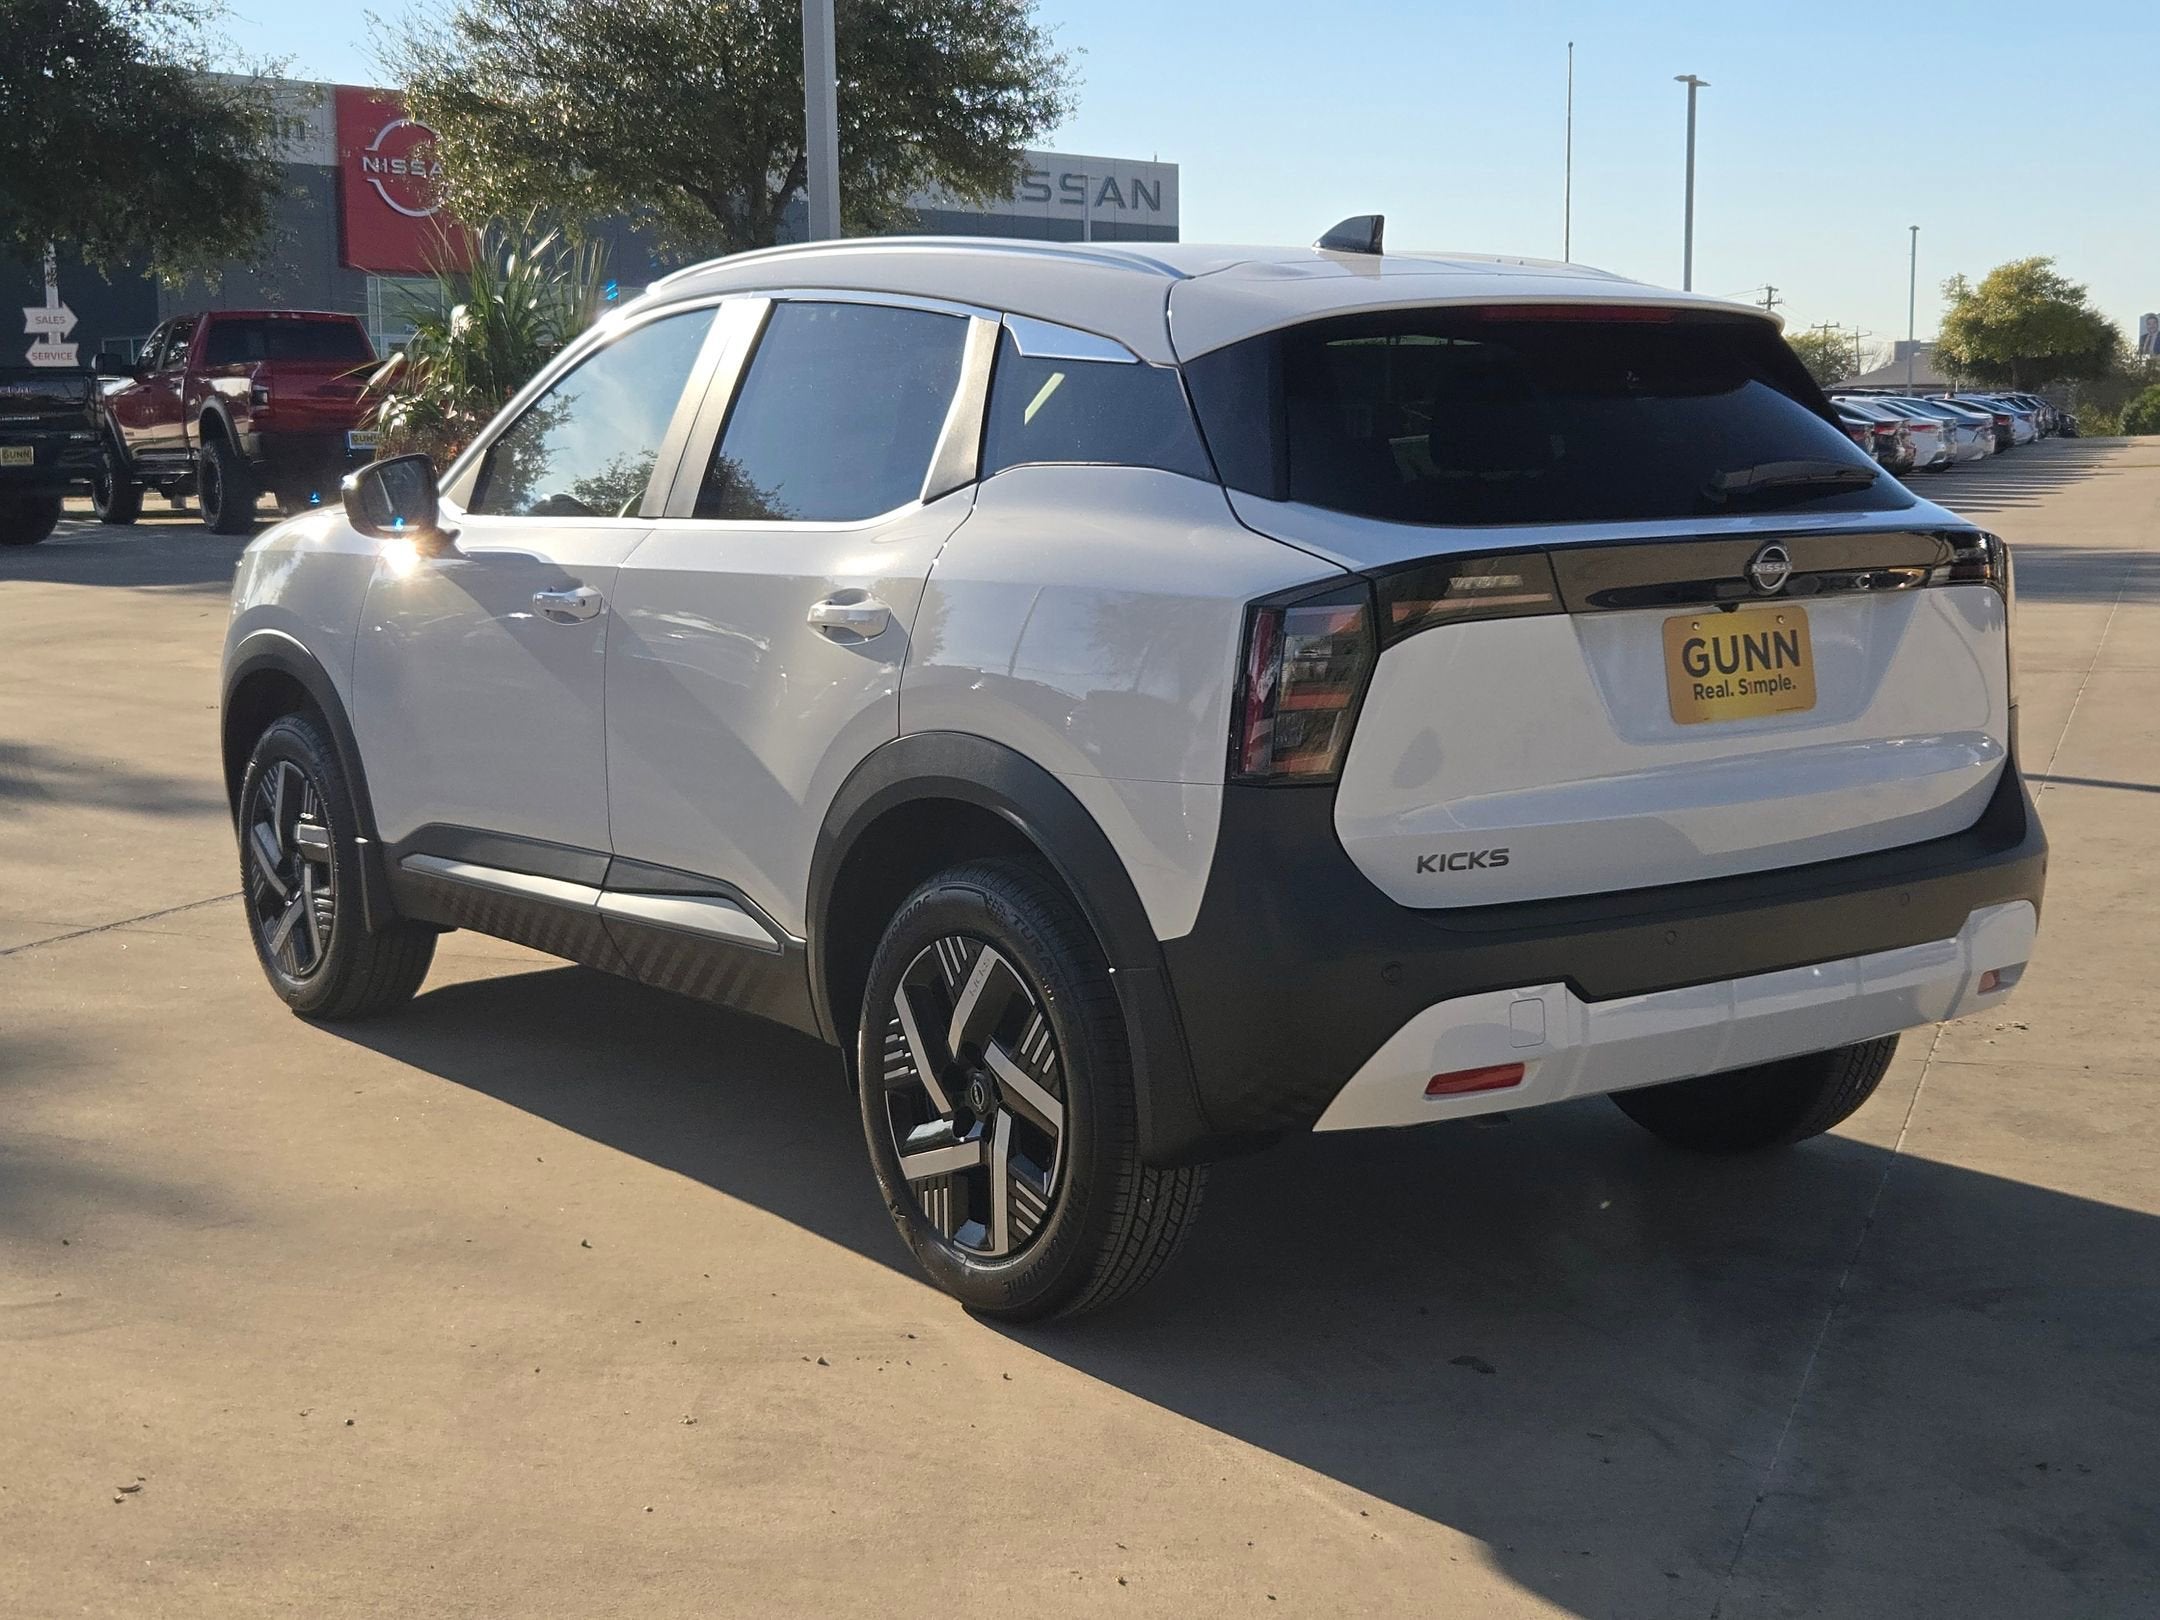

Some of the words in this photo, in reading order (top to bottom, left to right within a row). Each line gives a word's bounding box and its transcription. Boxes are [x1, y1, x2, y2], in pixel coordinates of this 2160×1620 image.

[362, 156, 445, 176] NISSA
[1019, 170, 1161, 212] SSAN
[35, 315, 66, 325] SALES
[31, 351, 73, 361] SERVICE
[1682, 629, 1801, 678] GUNN
[1693, 679, 1734, 701] Real.
[1416, 847, 1510, 874] KICKS
